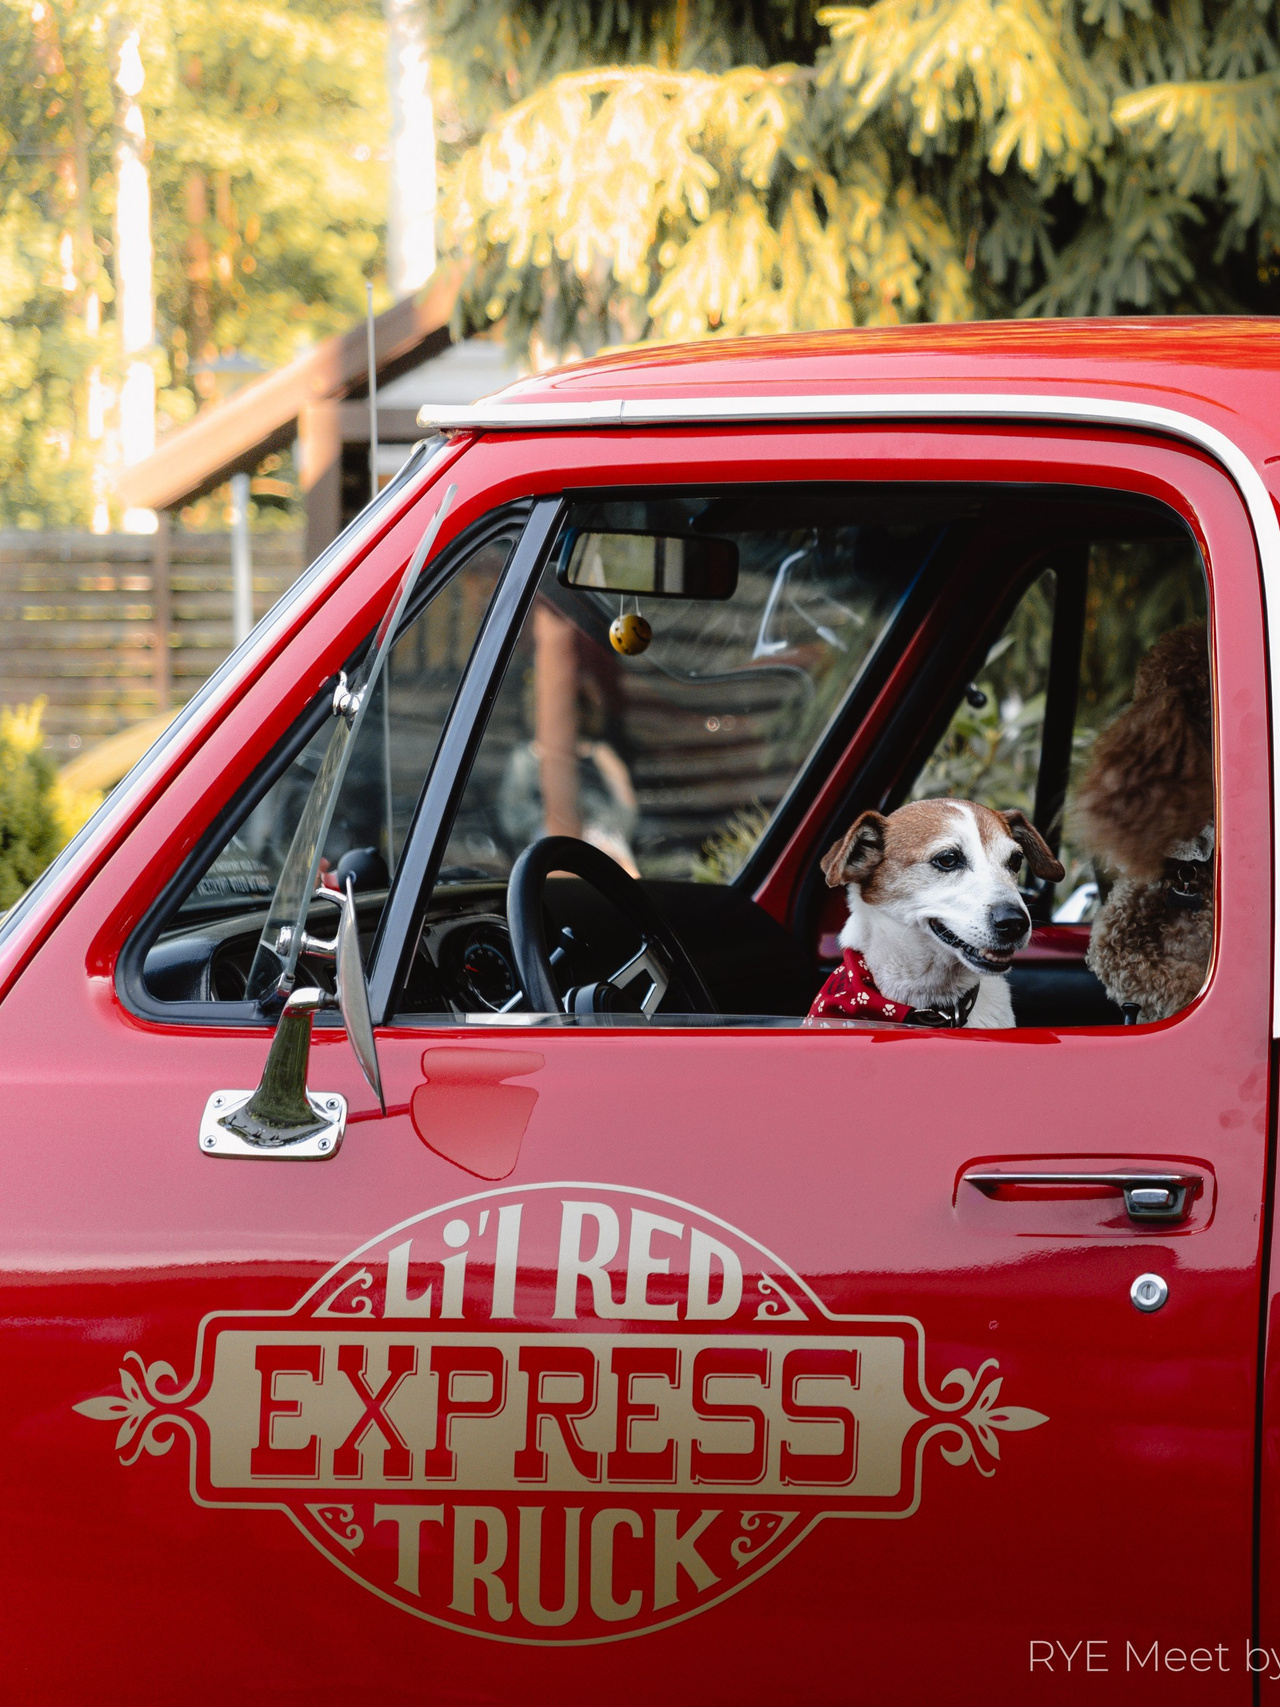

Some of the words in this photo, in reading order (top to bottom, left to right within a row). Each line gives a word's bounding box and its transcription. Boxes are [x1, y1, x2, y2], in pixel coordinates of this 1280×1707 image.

[382, 1203, 524, 1320] Li'l
[551, 1200, 744, 1321] RED
[250, 1345, 861, 1487] EXPRESS
[374, 1503, 722, 1627] TRUCK
